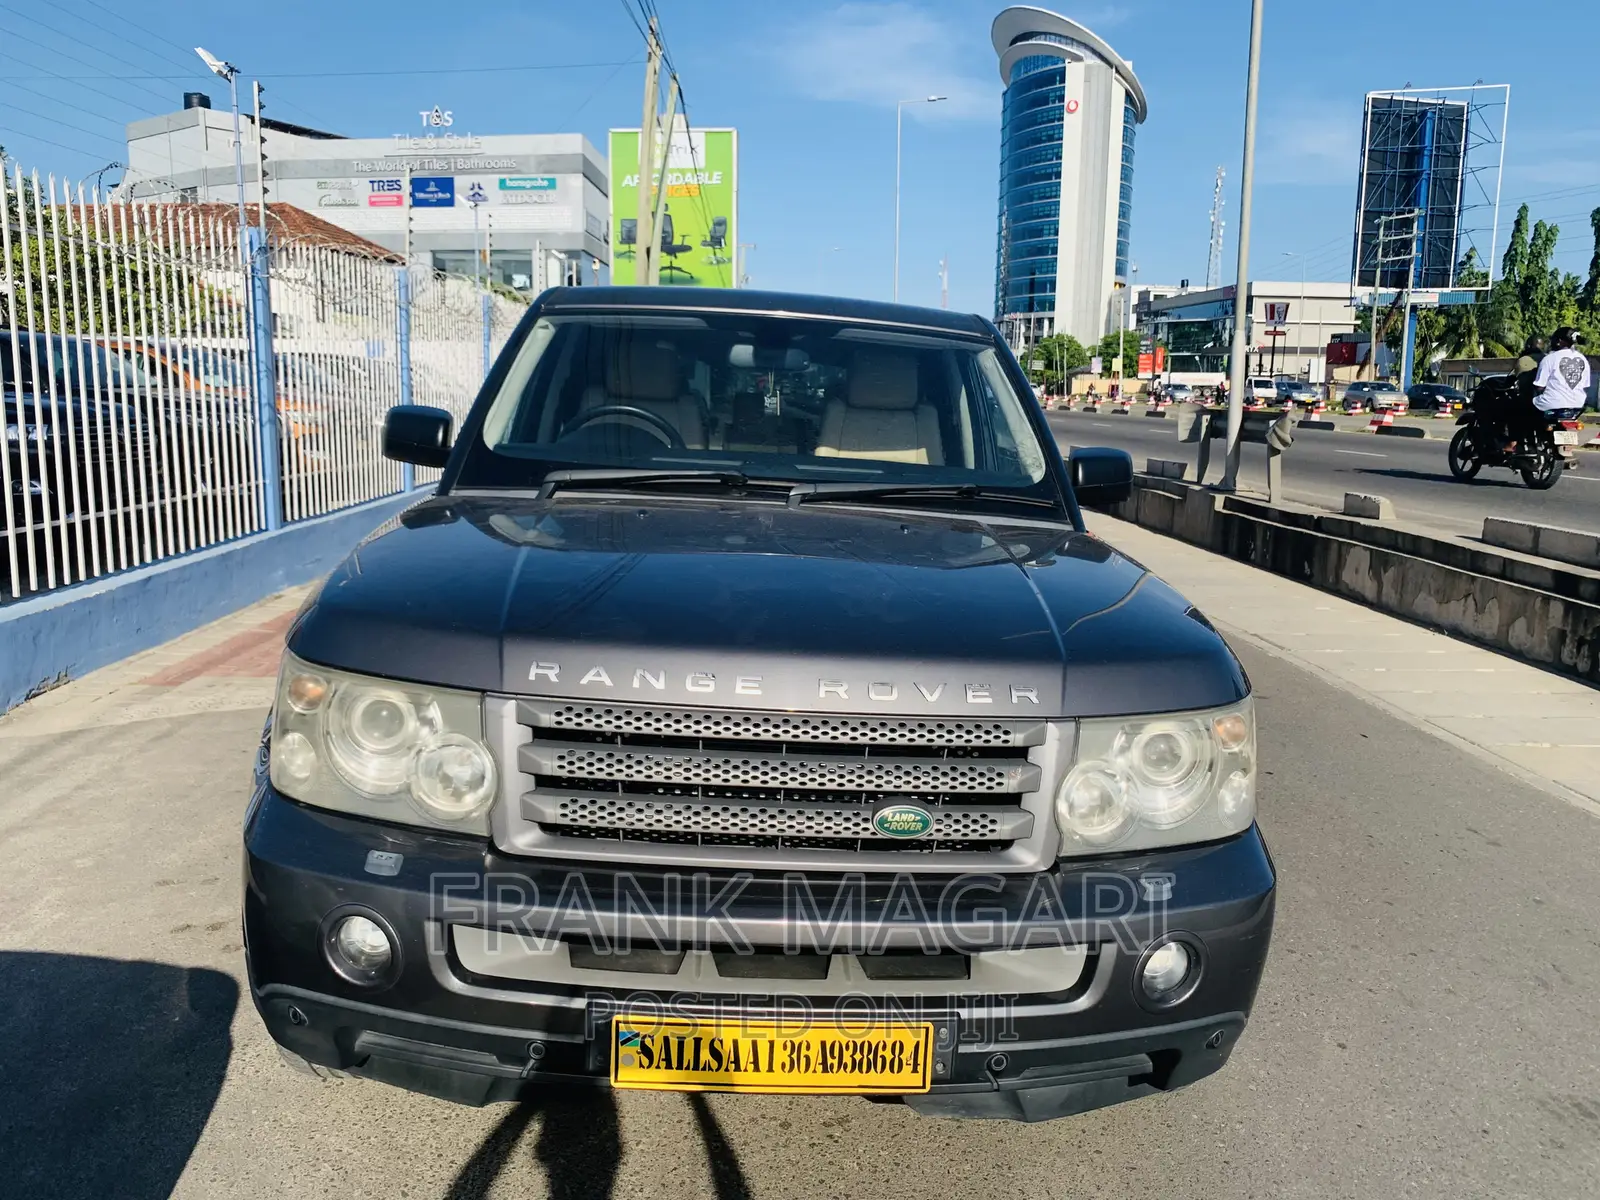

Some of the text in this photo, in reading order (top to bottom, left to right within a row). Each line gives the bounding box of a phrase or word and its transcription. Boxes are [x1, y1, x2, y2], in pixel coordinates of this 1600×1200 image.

[420, 105, 453, 127] T&S
[393, 131, 482, 150] Tile & Style
[353, 161, 373, 172] The
[373, 160, 408, 172] World
[409, 159, 421, 171] of
[424, 158, 448, 170] Tiles
[457, 157, 517, 169] Bathrooms
[369, 180, 402, 192] TRES
[622, 172, 722, 186] AFODABLE
[528, 660, 1042, 704] RANGE ROVER
[888, 812, 915, 822] LAND
[889, 821, 923, 831] ROVER
